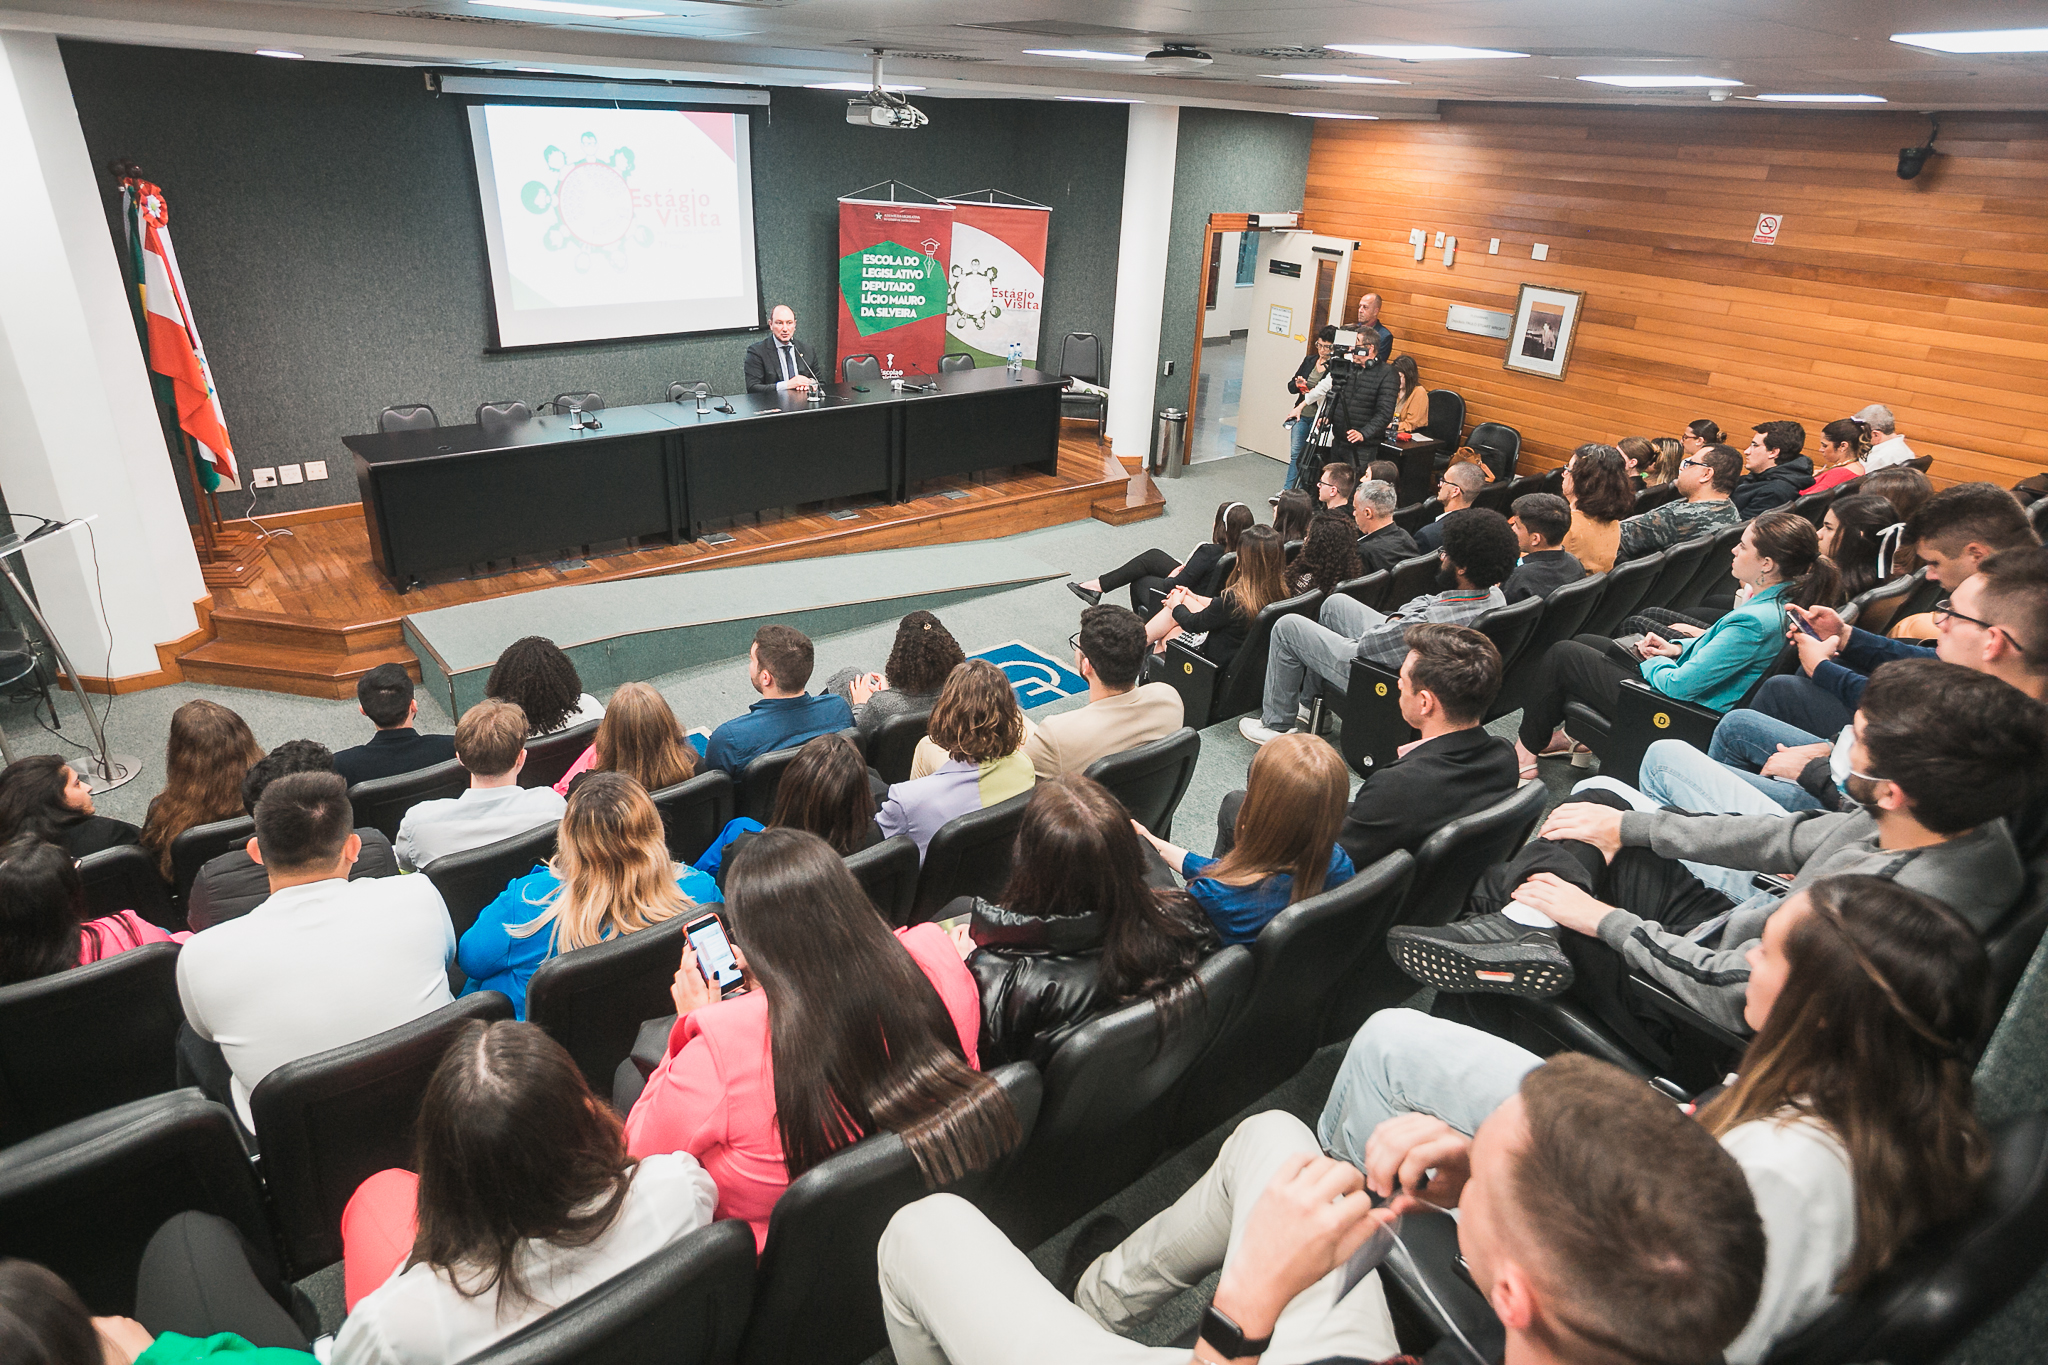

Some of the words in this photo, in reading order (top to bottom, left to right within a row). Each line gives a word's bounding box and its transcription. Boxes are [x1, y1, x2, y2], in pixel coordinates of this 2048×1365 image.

[629, 188, 710, 212] Estágio
[863, 254, 902, 265] ESCOLA
[904, 256, 920, 267] DO
[862, 267, 924, 280] LEGISLATIVO
[861, 280, 916, 292] DEPUTADO
[861, 291, 889, 304] LÍCIO
[888, 294, 926, 306] MAURO
[992, 287, 1035, 302] Estágio
[1003, 298, 1039, 310] Visita
[860, 306, 876, 317] DA
[875, 307, 918, 318] SILVEIRA
[1658, 716, 1666, 725] D
